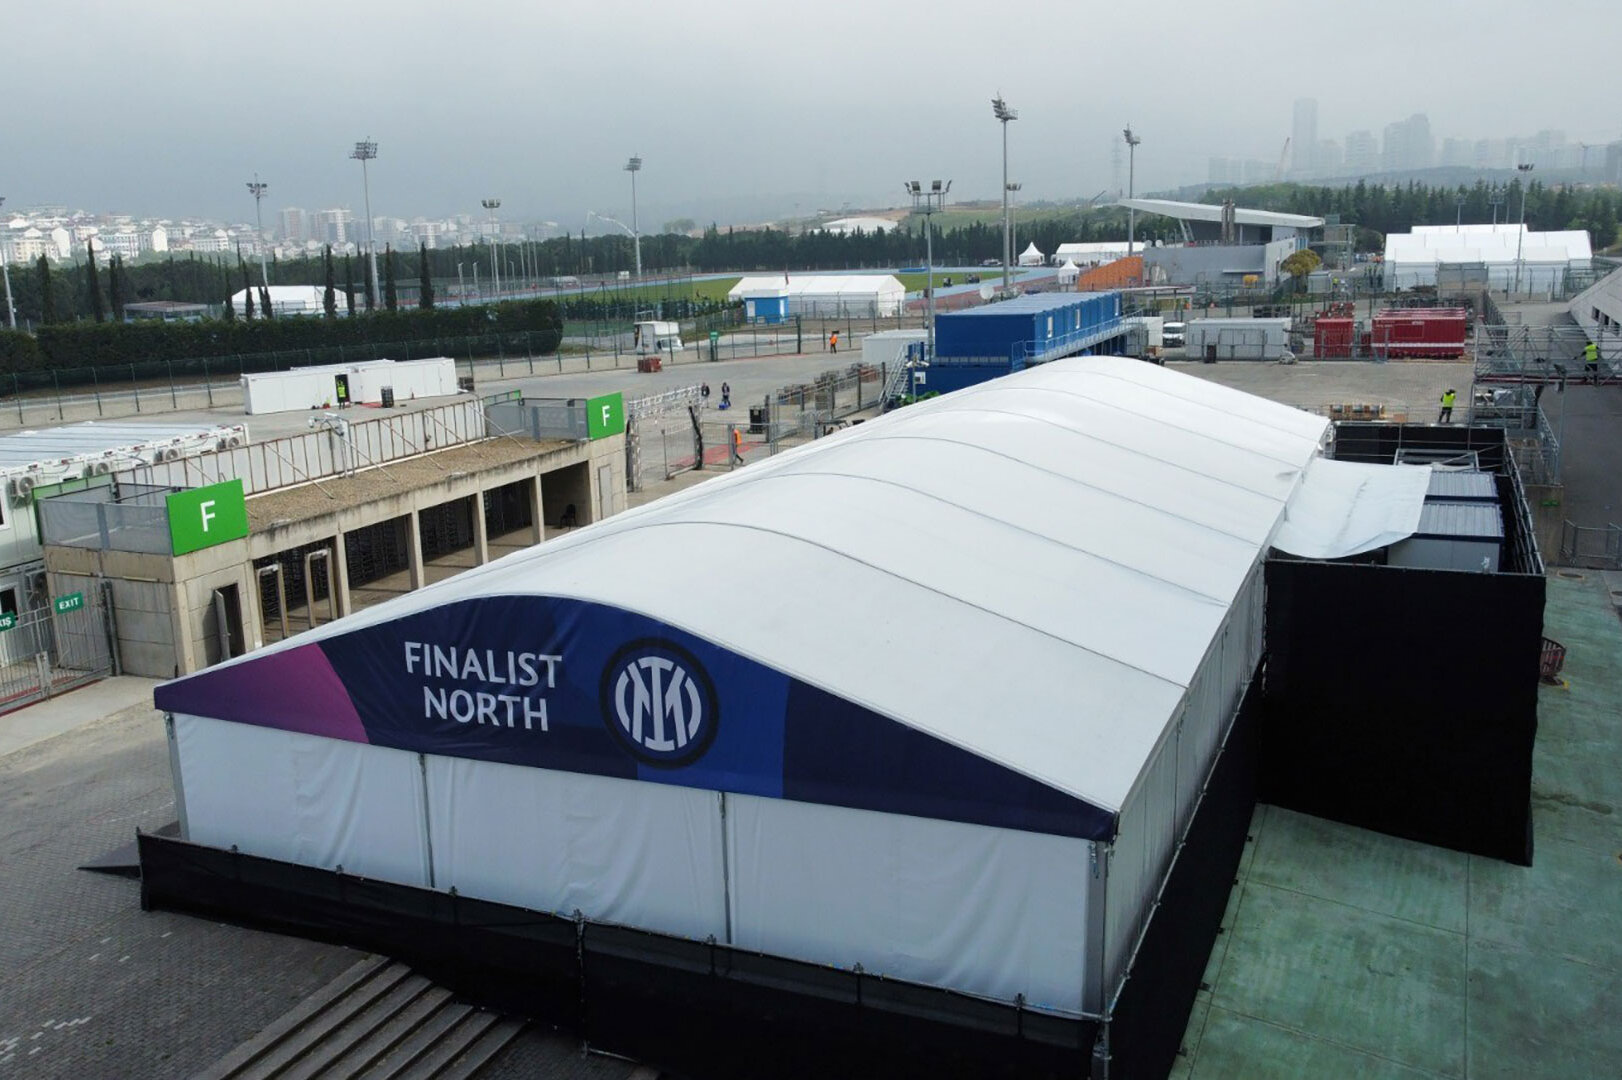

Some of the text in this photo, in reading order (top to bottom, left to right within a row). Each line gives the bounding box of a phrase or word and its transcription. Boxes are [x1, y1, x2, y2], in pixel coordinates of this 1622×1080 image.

[602, 405, 610, 427] F
[200, 500, 216, 532] F
[59, 597, 79, 610] EXIT
[404, 641, 563, 689] FINALIST
[423, 685, 549, 732] NORTH
